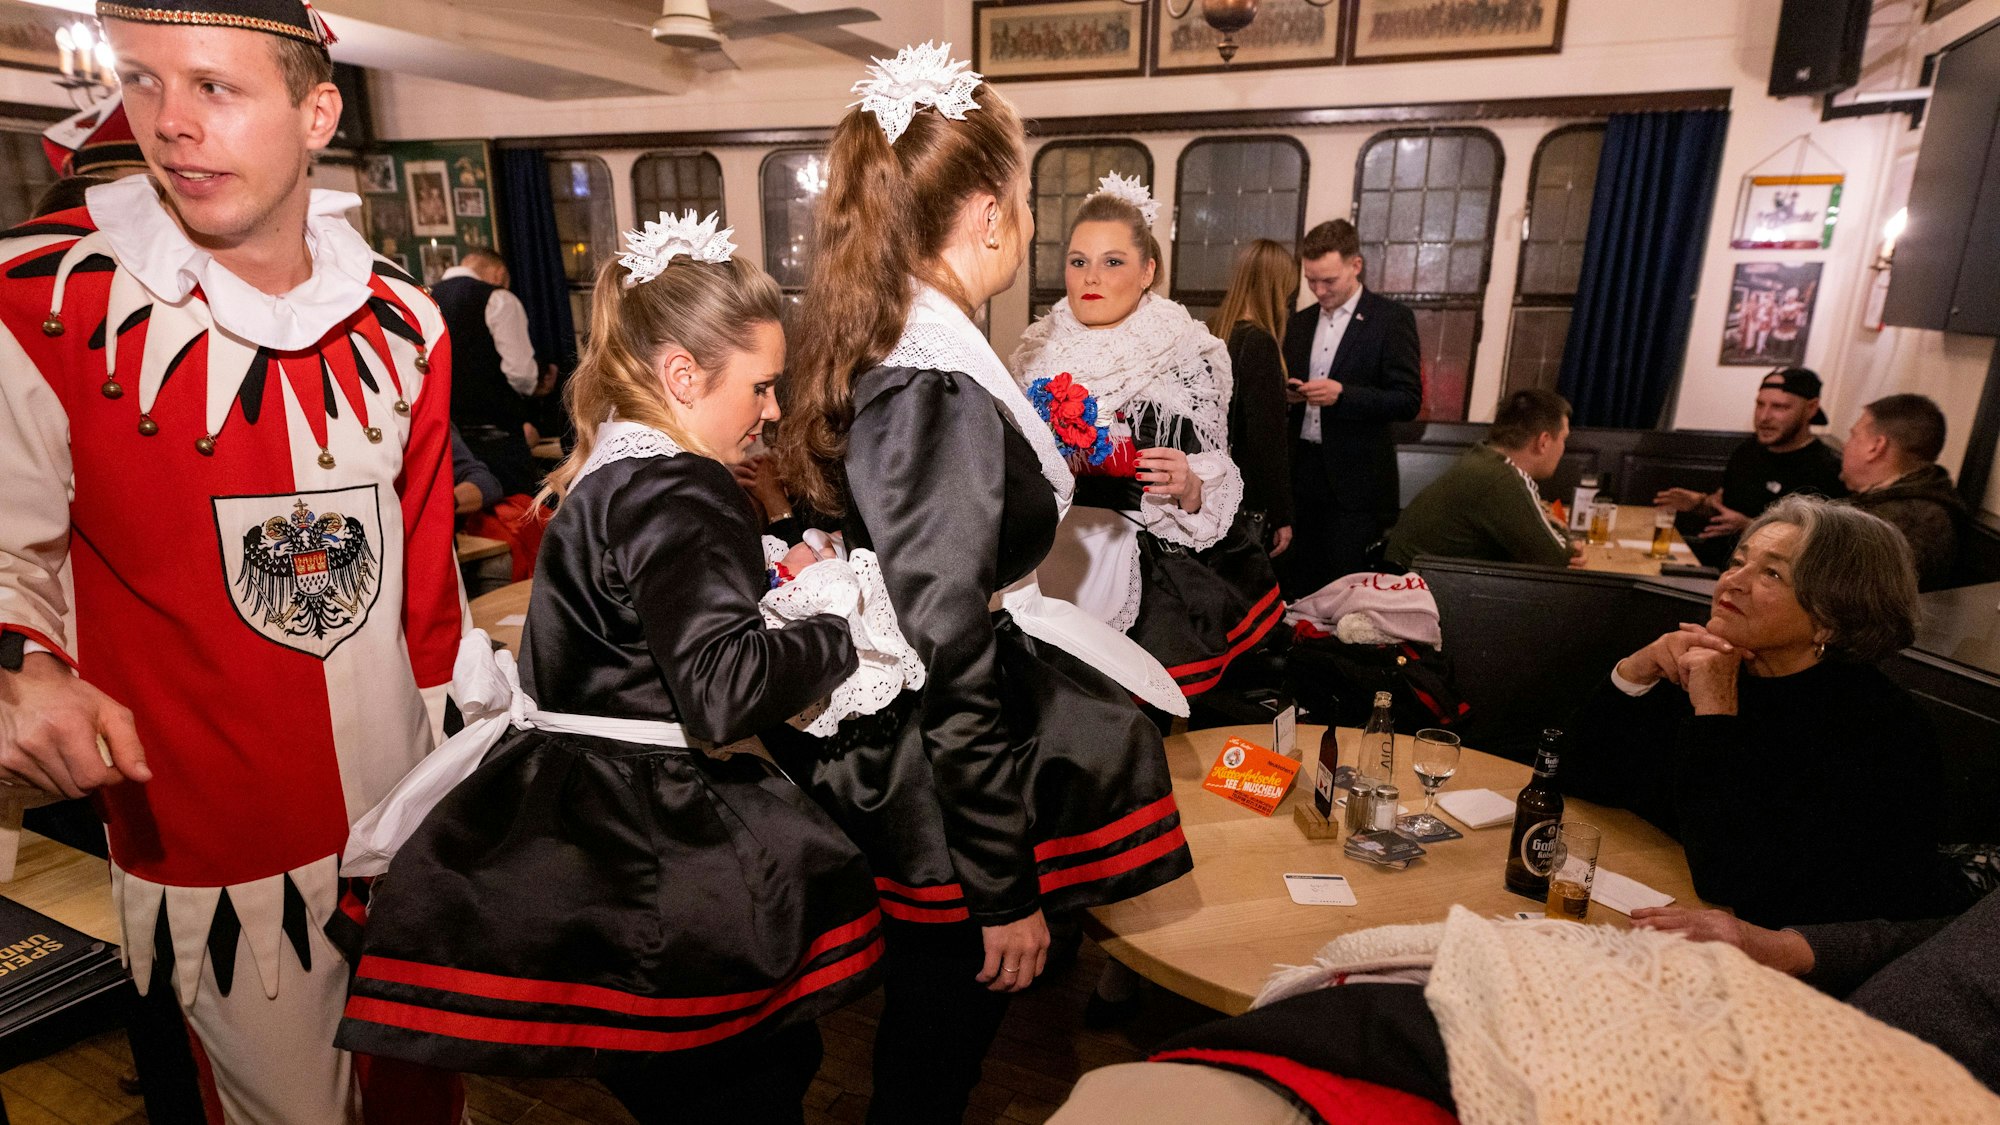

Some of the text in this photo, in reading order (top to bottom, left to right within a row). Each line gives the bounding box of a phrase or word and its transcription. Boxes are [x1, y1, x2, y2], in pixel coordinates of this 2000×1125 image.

[1211, 766, 1282, 791] Kutterfrische
[1223, 778, 1284, 798] SEE MUSCHELN
[0, 934, 50, 960] UND
